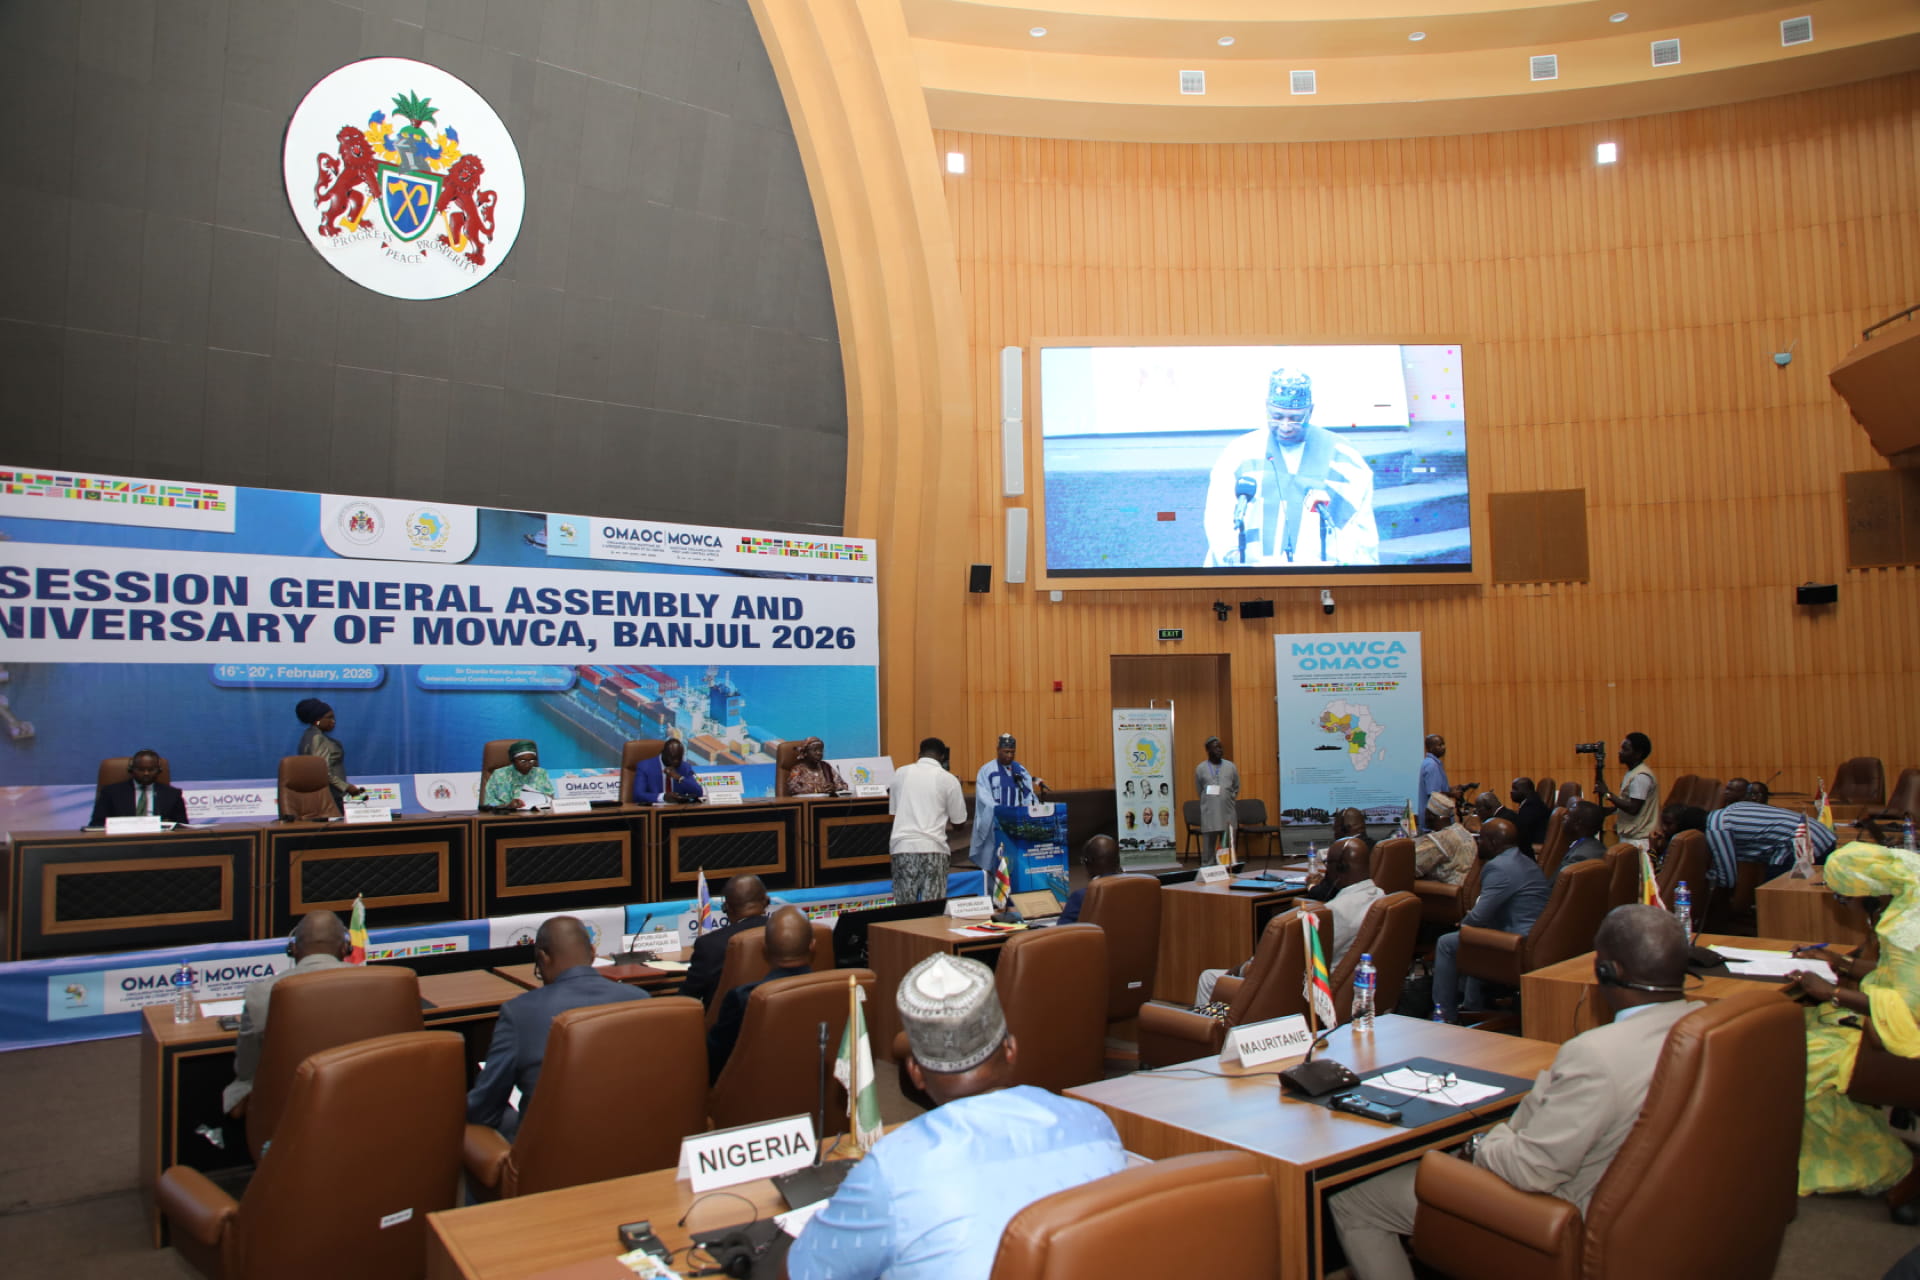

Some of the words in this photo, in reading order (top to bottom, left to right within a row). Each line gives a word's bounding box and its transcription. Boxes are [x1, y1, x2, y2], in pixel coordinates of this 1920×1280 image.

[386, 248, 423, 263] PEACE
[416, 239, 478, 274] PROSPERITY
[602, 526, 663, 544] OMAOC
[668, 532, 723, 548] MOWCA
[0, 566, 248, 606] SESSION
[270, 578, 493, 612] GENERAL
[505, 587, 720, 618] ASSEMBLY
[731, 595, 804, 621] AND
[0, 606, 317, 642] NIVERSARY
[333, 615, 395, 644] OF
[413, 617, 597, 653] MOWCA,
[613, 622, 761, 648] BANJUL
[772, 625, 856, 649] 2026
[1291, 641, 1407, 656] MOWCA
[1298, 656, 1400, 671] OMAOC
[277, 667, 339, 680] February,
[343, 668, 373, 679] 2026
[1132, 751, 1147, 763] 50
[565, 781, 604, 791] OMAOC
[213, 793, 262, 804] MOWCA
[205, 963, 275, 983] MOWCA
[1239, 1029, 1309, 1056] MAURITANIE
[698, 1131, 810, 1174] NIGERIA
